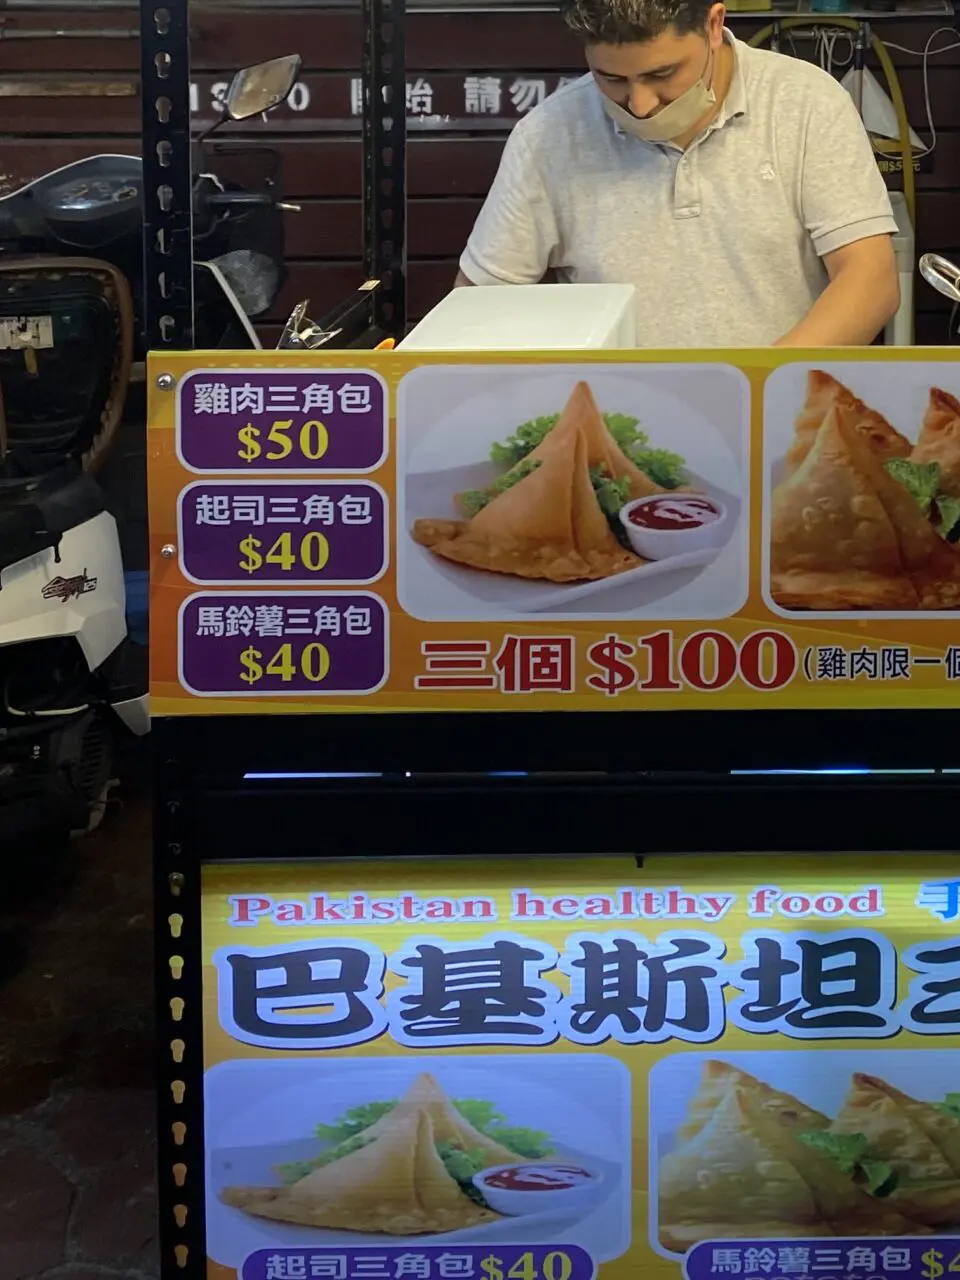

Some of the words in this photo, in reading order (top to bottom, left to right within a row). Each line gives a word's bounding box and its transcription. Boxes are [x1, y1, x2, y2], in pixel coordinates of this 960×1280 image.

[194, 382, 372, 415] 雞肉三角包
[236, 420, 329, 462] $50
[195, 494, 373, 527] 起司三角包
[238, 531, 330, 573] $40
[196, 605, 372, 638] 馬鈴薯三角包
[238, 641, 330, 684] $40
[415, 634, 573, 692] 三個
[588, 629, 797, 697] $100
[234, 894, 494, 923] Pakistan
[517, 888, 734, 920] healthy
[751, 887, 881, 916] food
[265, 1252, 476, 1280] 起司三角包
[479, 1251, 573, 1280] $40
[709, 1245, 912, 1274] 馬鈴薯三角包
